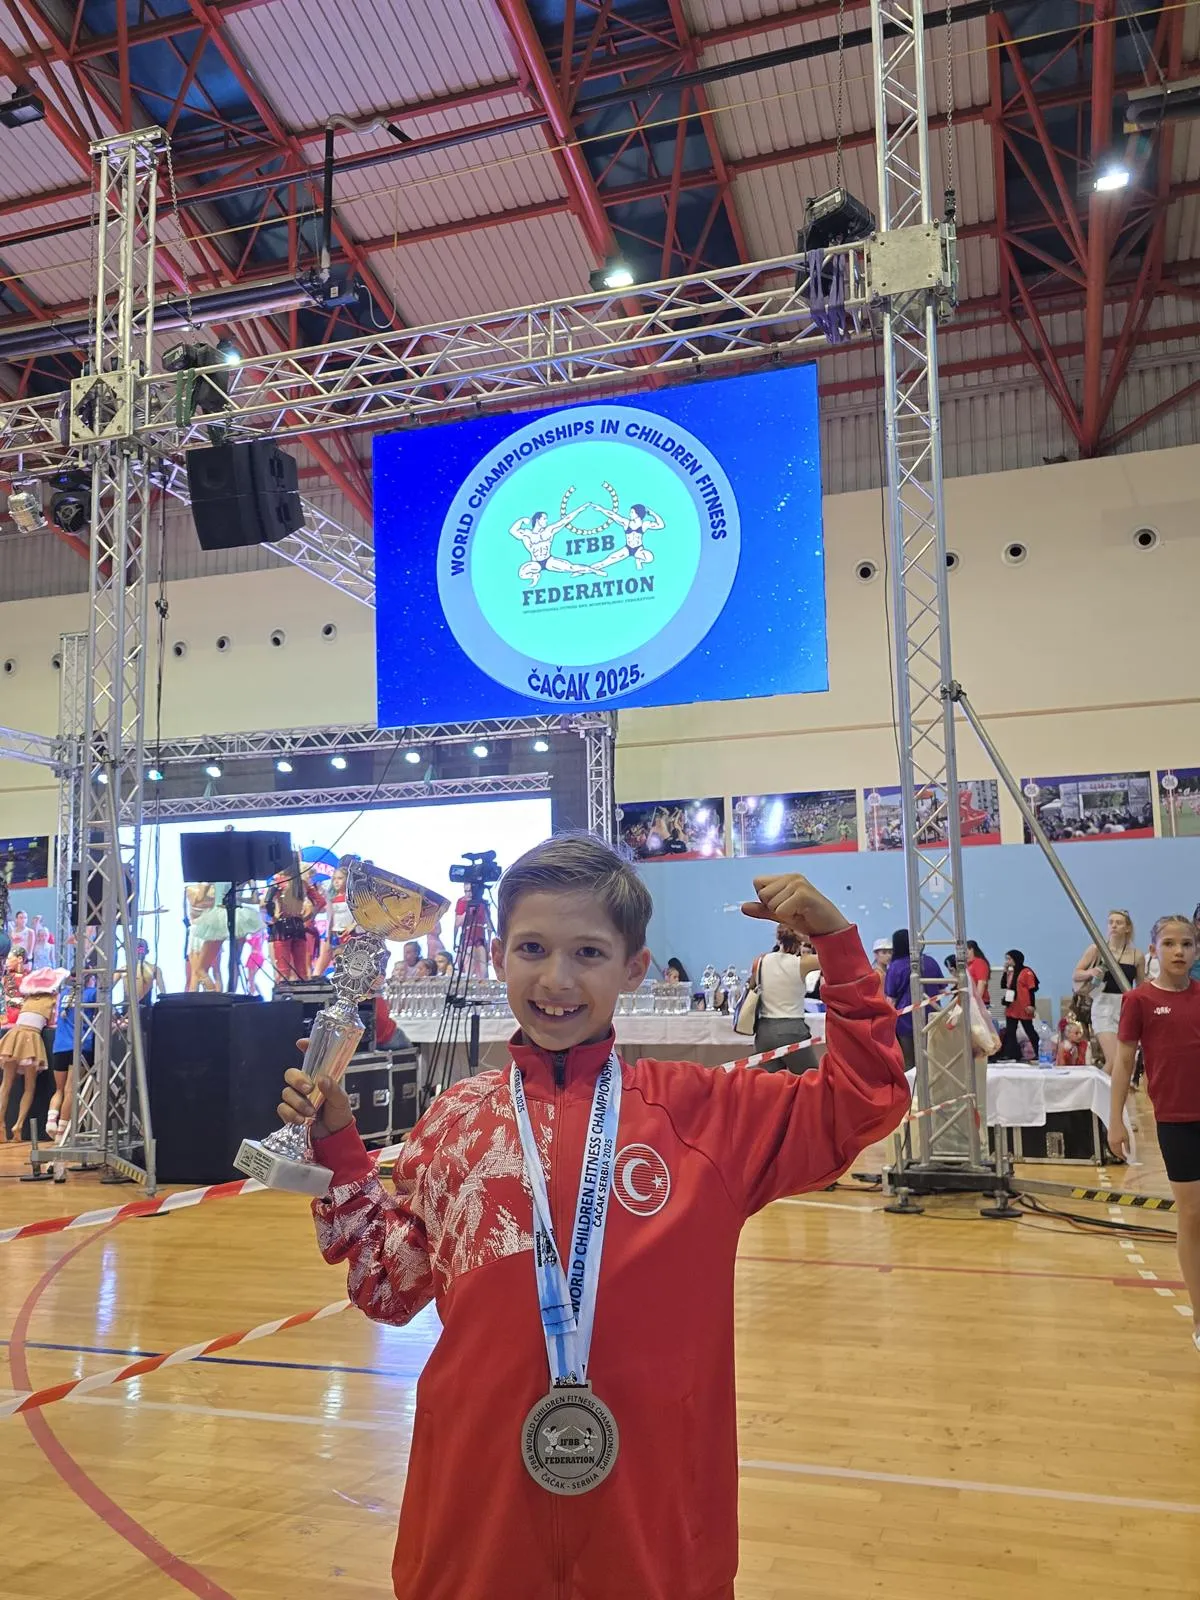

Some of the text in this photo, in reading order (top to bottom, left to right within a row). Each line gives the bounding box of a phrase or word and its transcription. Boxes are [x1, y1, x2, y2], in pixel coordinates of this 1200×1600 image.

[451, 419, 727, 576] WORLD CHAMPIONSHIPS IN CHILDREN FITNESS
[565, 534, 616, 558] IFBB
[522, 575, 655, 606] FEDERATION
[527, 663, 646, 701] ČAČAK 2025.
[516, 1095, 526, 1113] 2025
[585, 1137, 602, 1186] FITNESS
[593, 1138, 613, 1228] ČAČAK SERBIA 2025
[575, 1189, 594, 1256] CHILDREN
[569, 1259, 585, 1313] WORLD
[526, 1395, 614, 1472] IFBB WORLD CHILDREN FITNESS CHAMPIONSHIPS
[560, 1438, 580, 1446] IFBB
[545, 1456, 595, 1464] FEDERATION
[572, 1473, 600, 1489] SERBIA
